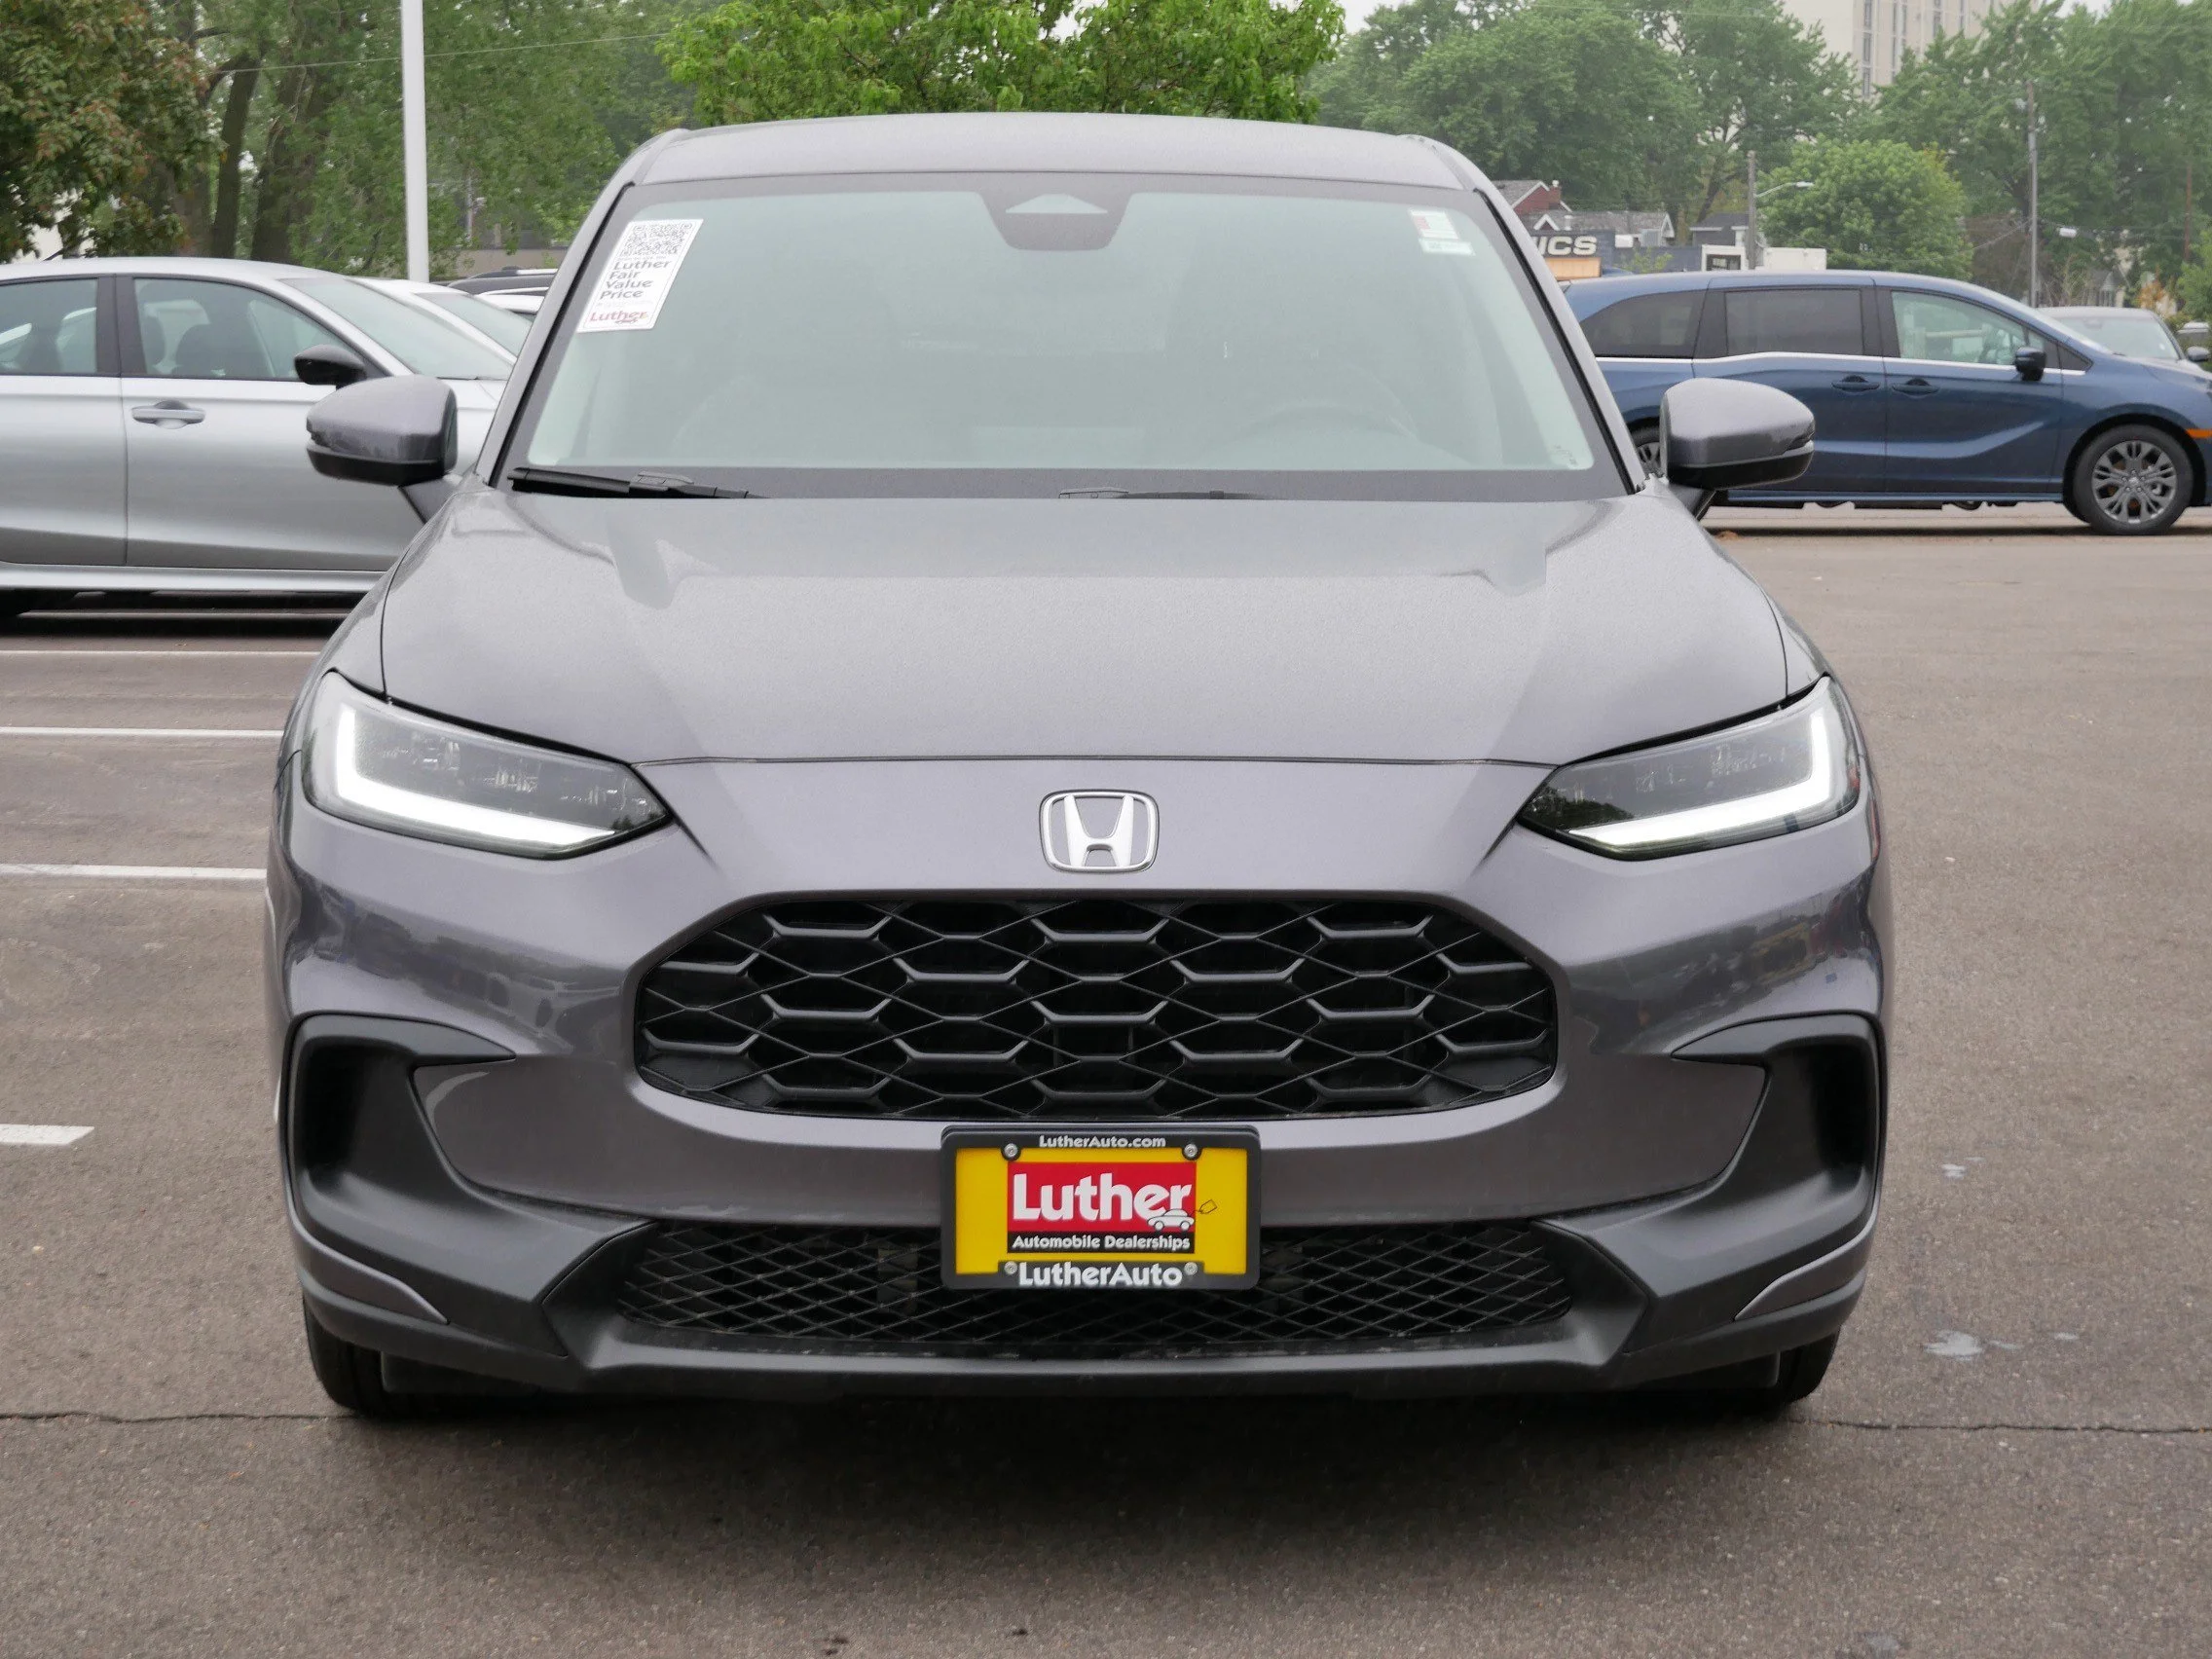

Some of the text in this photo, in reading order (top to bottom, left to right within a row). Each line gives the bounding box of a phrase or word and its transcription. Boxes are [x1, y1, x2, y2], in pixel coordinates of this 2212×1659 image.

[613, 260, 672, 270] Luther
[609, 270, 642, 279] Fair
[607, 279, 653, 288] Value
[600, 289, 644, 300] Price
[590, 311, 647, 321] Luther
[1039, 1135, 1166, 1148] LutherAuto.com
[1013, 1172, 1192, 1221] Luther
[1012, 1235, 1191, 1251] Automobile Dealerships
[1018, 1261, 1183, 1287] LutherAuto
